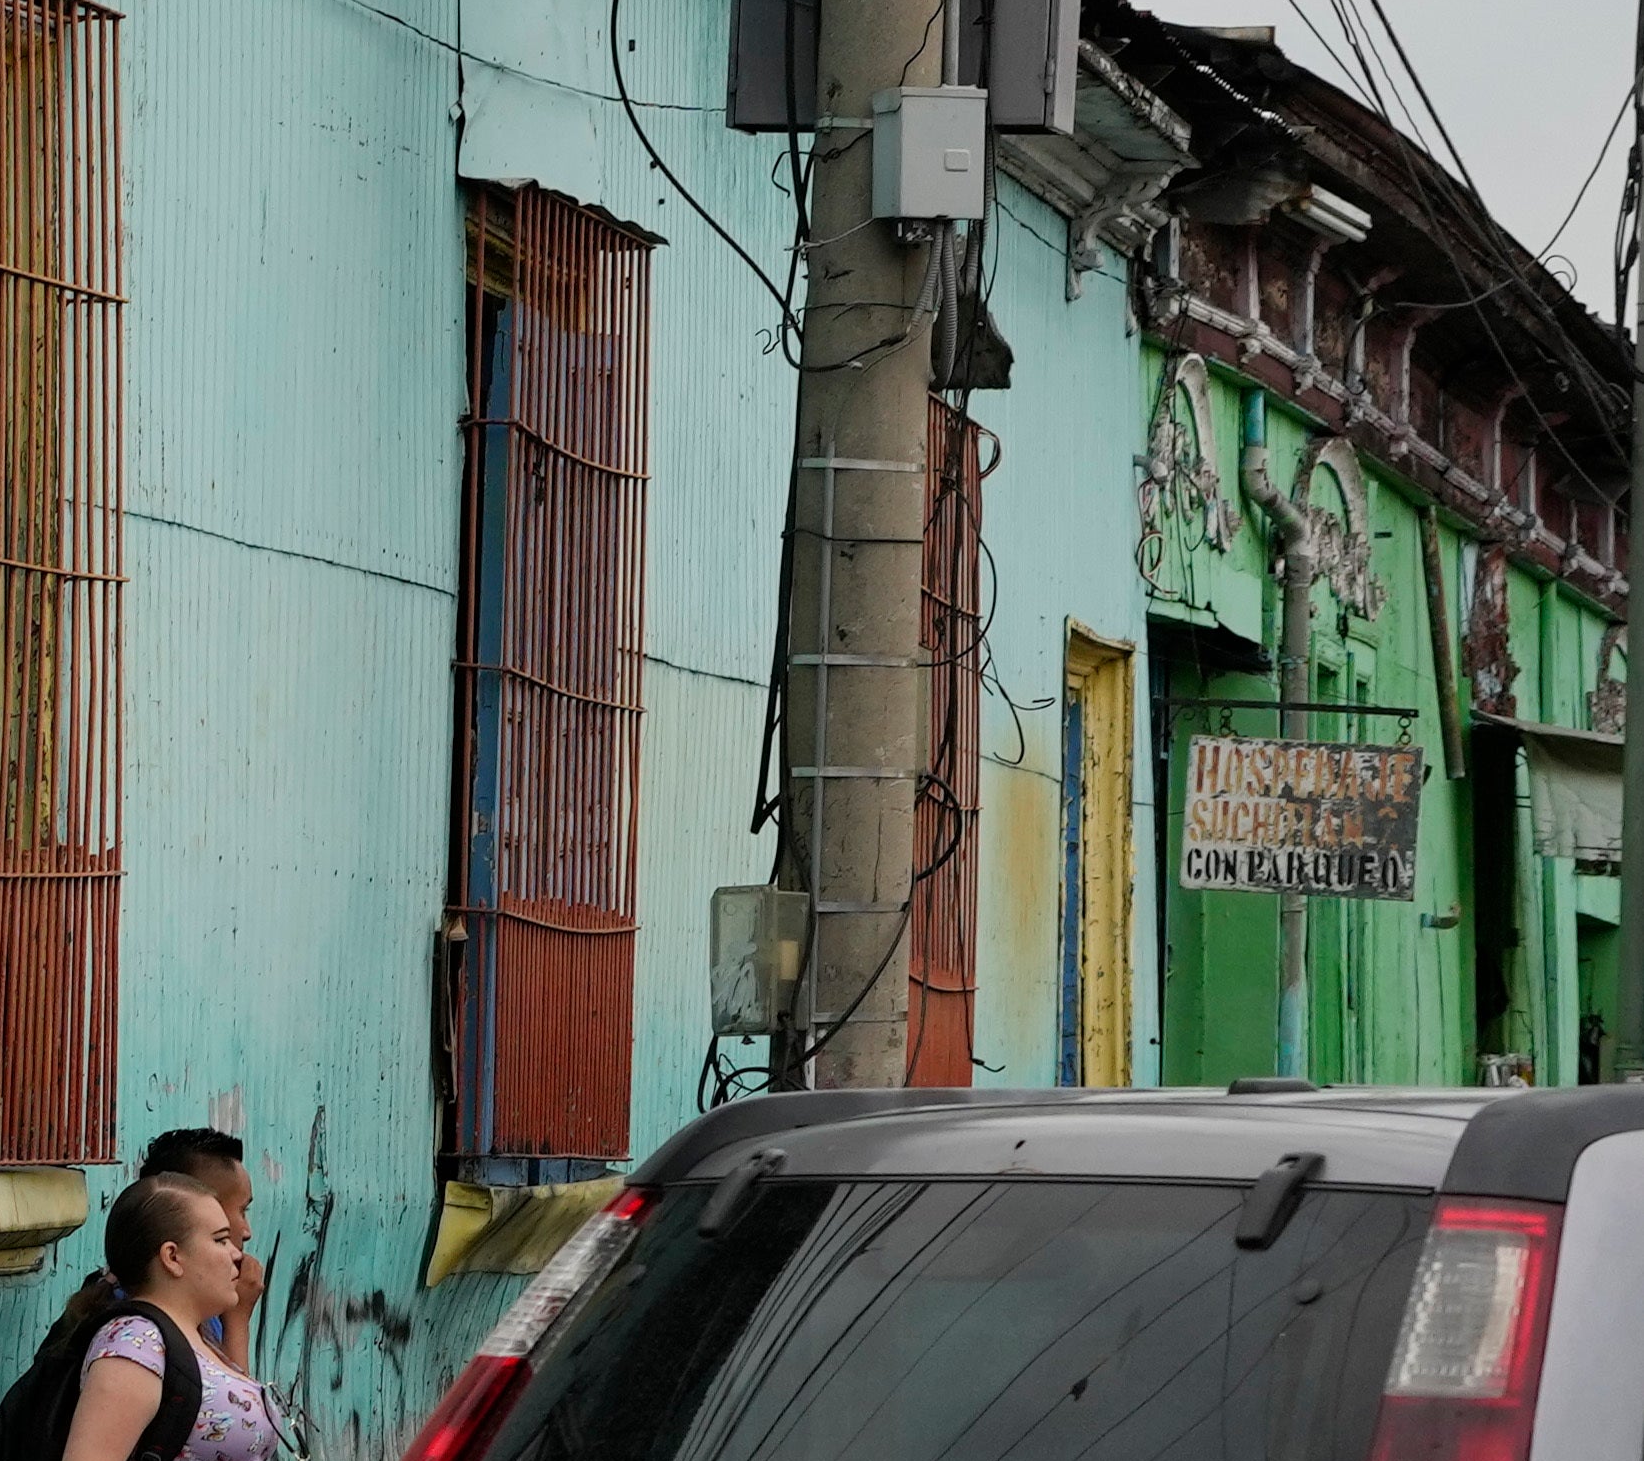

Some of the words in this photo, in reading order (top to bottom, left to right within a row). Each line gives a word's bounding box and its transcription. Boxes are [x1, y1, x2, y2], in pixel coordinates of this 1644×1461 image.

[1196, 744, 1416, 803] HOSPEDAJE
[1187, 847, 1237, 885] CON
[1247, 848, 1399, 888] PARQUEO
